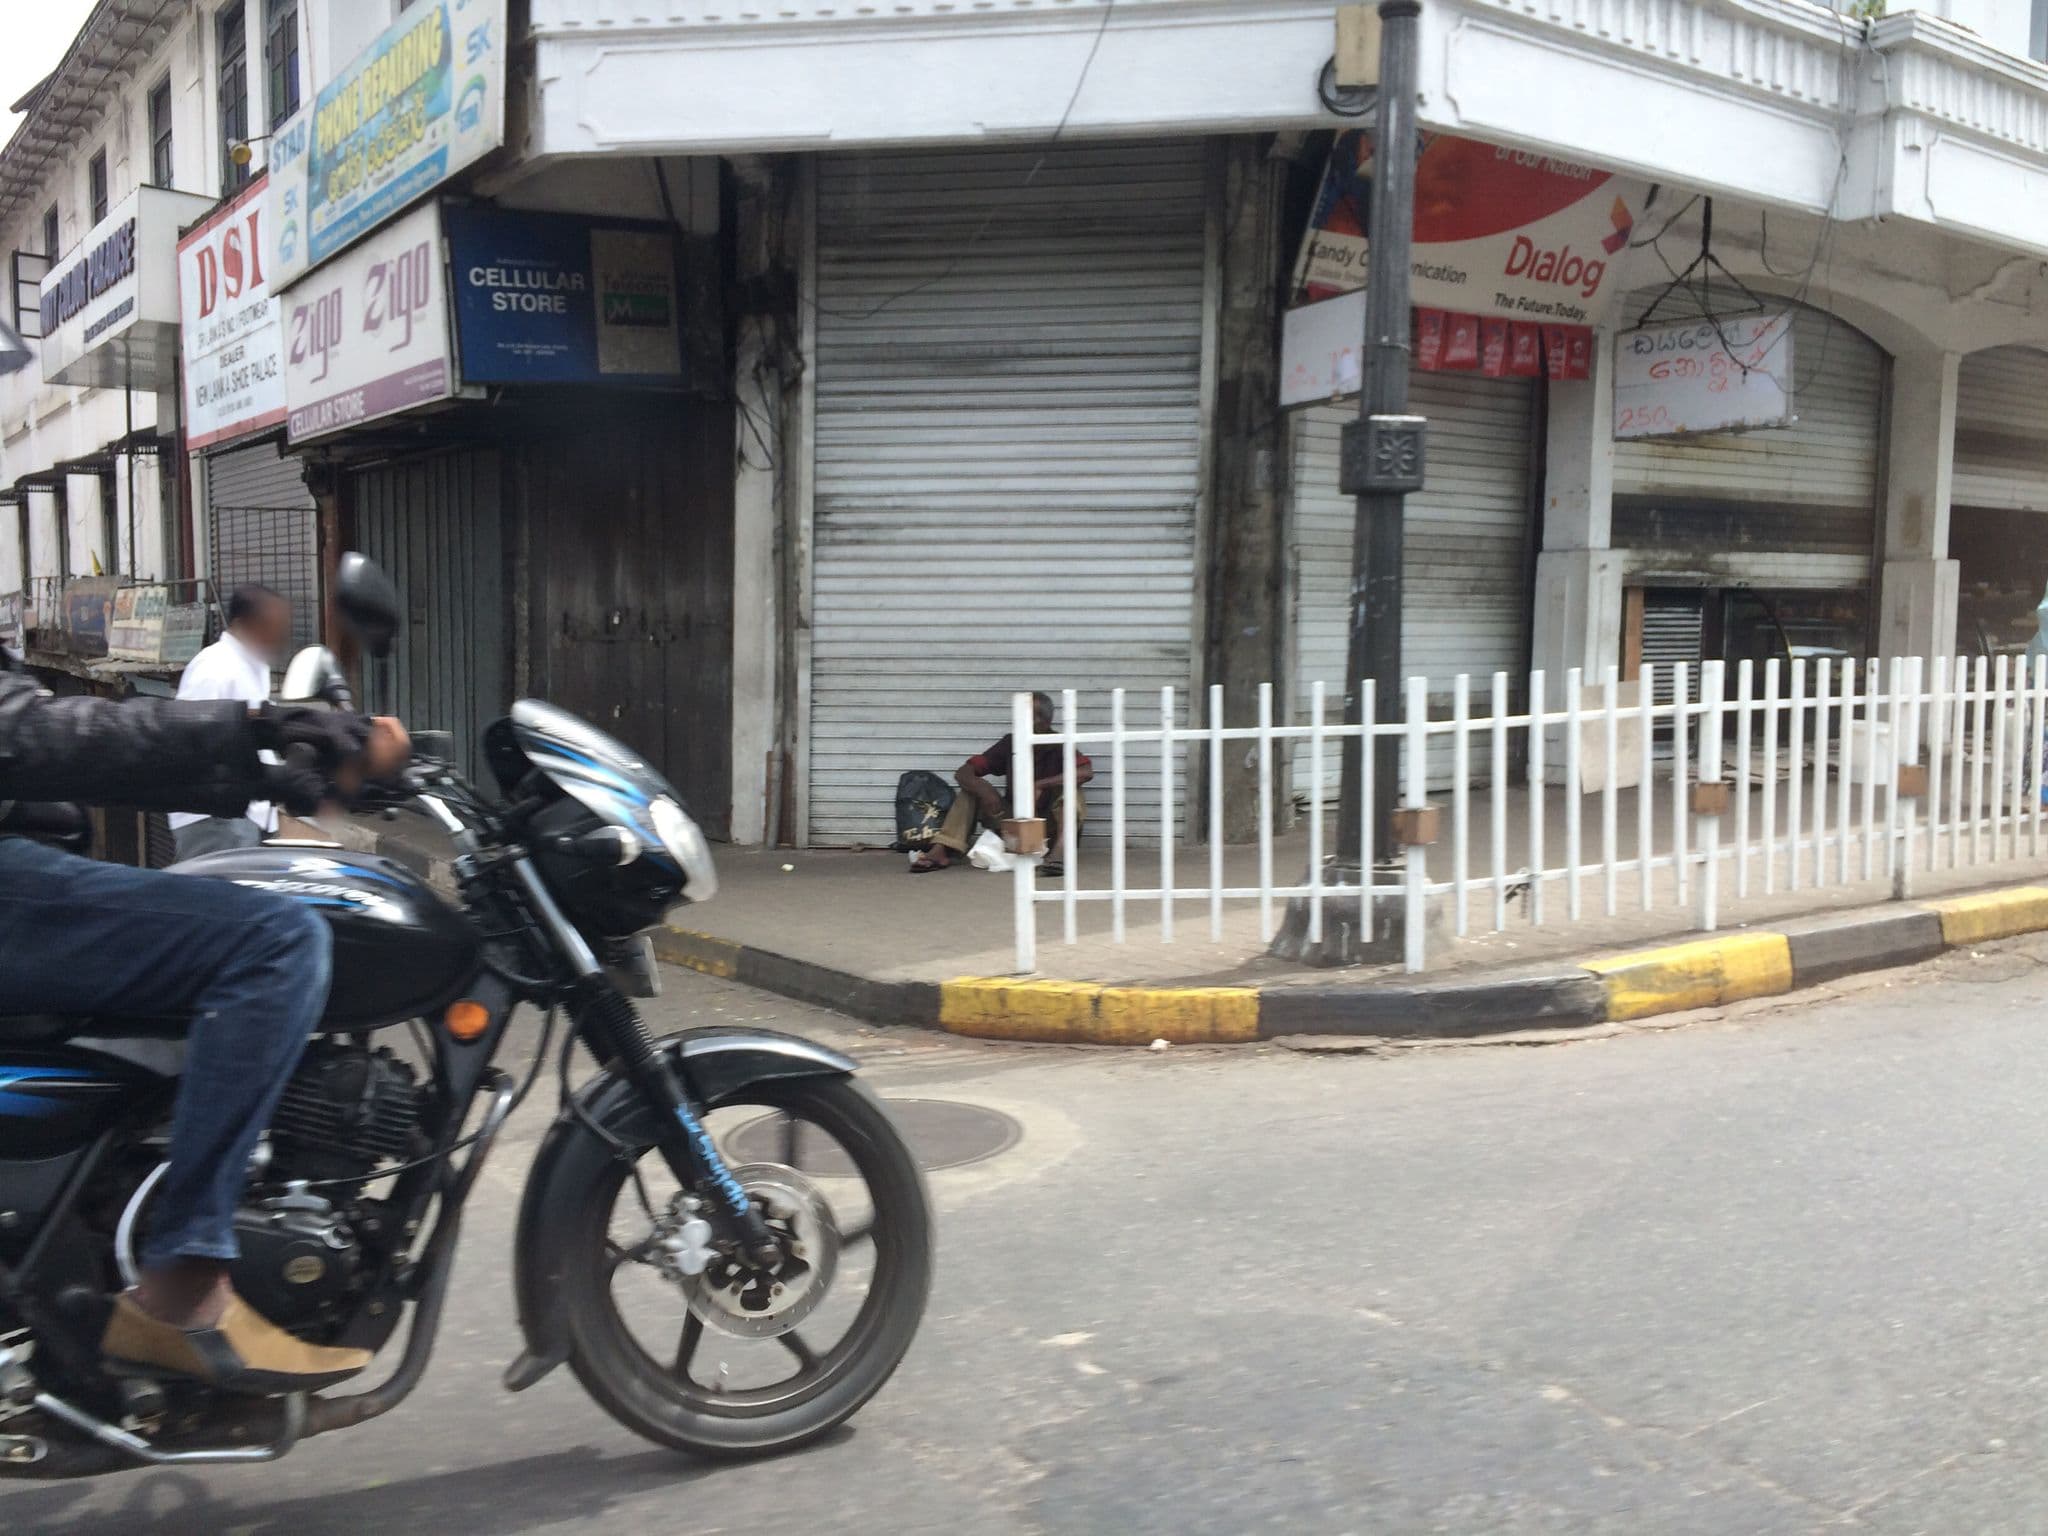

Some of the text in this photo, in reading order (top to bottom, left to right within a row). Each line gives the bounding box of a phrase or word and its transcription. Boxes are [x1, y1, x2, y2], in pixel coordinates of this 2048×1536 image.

[317, 77, 360, 160] PHONE
[362, 5, 443, 122] REPAIRING
[196, 208, 265, 321] DSI
[468, 267, 585, 291] CELLULAR
[1504, 234, 1607, 299] Dialog
[492, 291, 567, 314] STORE
[1495, 293, 1513, 309] The
[219, 345, 246, 369] DEALER
[232, 367, 250, 394] SHOE
[251, 353, 278, 385] PALACE
